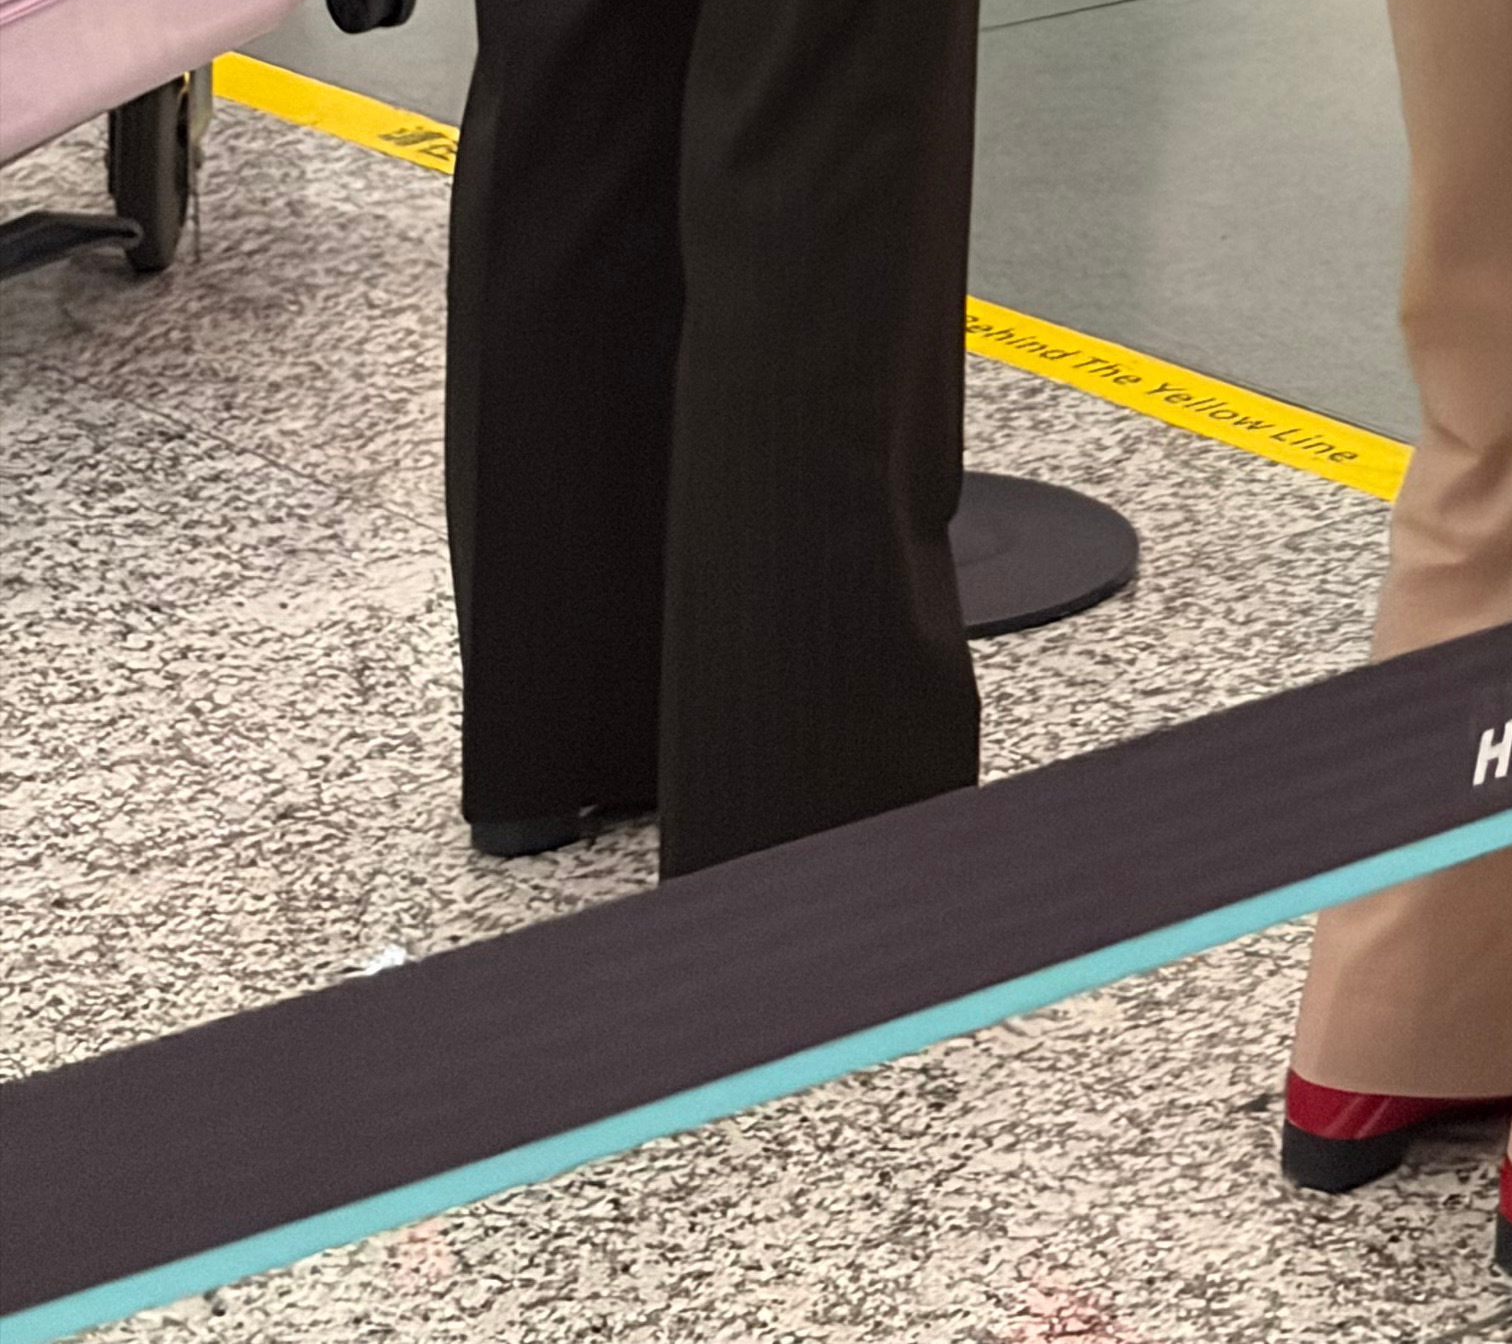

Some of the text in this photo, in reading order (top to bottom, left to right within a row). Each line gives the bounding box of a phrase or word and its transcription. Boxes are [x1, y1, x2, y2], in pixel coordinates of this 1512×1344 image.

[1073, 356, 1143, 387] The
[1146, 382, 1276, 432] Yellow
[1270, 428, 1359, 464] Line
